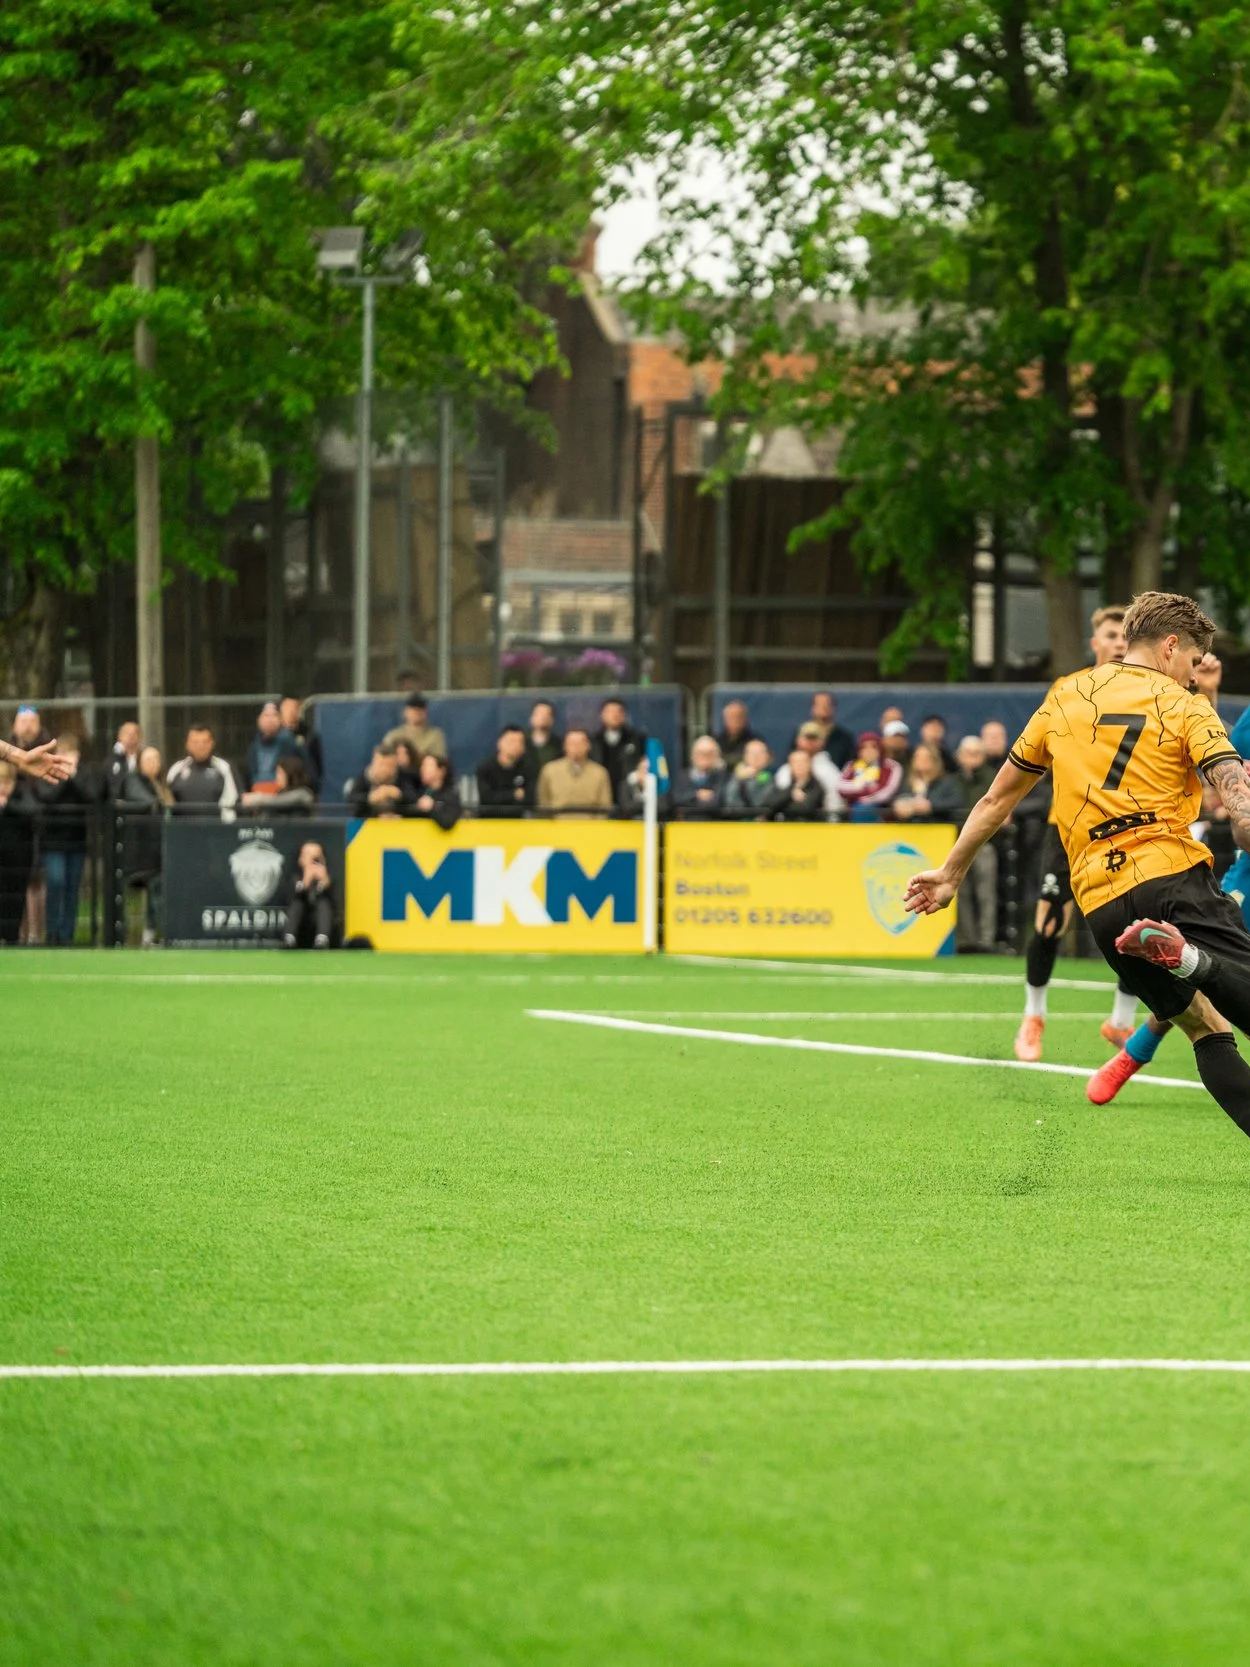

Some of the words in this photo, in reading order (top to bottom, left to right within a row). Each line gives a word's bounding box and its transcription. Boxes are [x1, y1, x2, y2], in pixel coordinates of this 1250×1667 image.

[1097, 713, 1147, 791] 7
[381, 845, 637, 926] MKM
[675, 879, 748, 896] Boston
